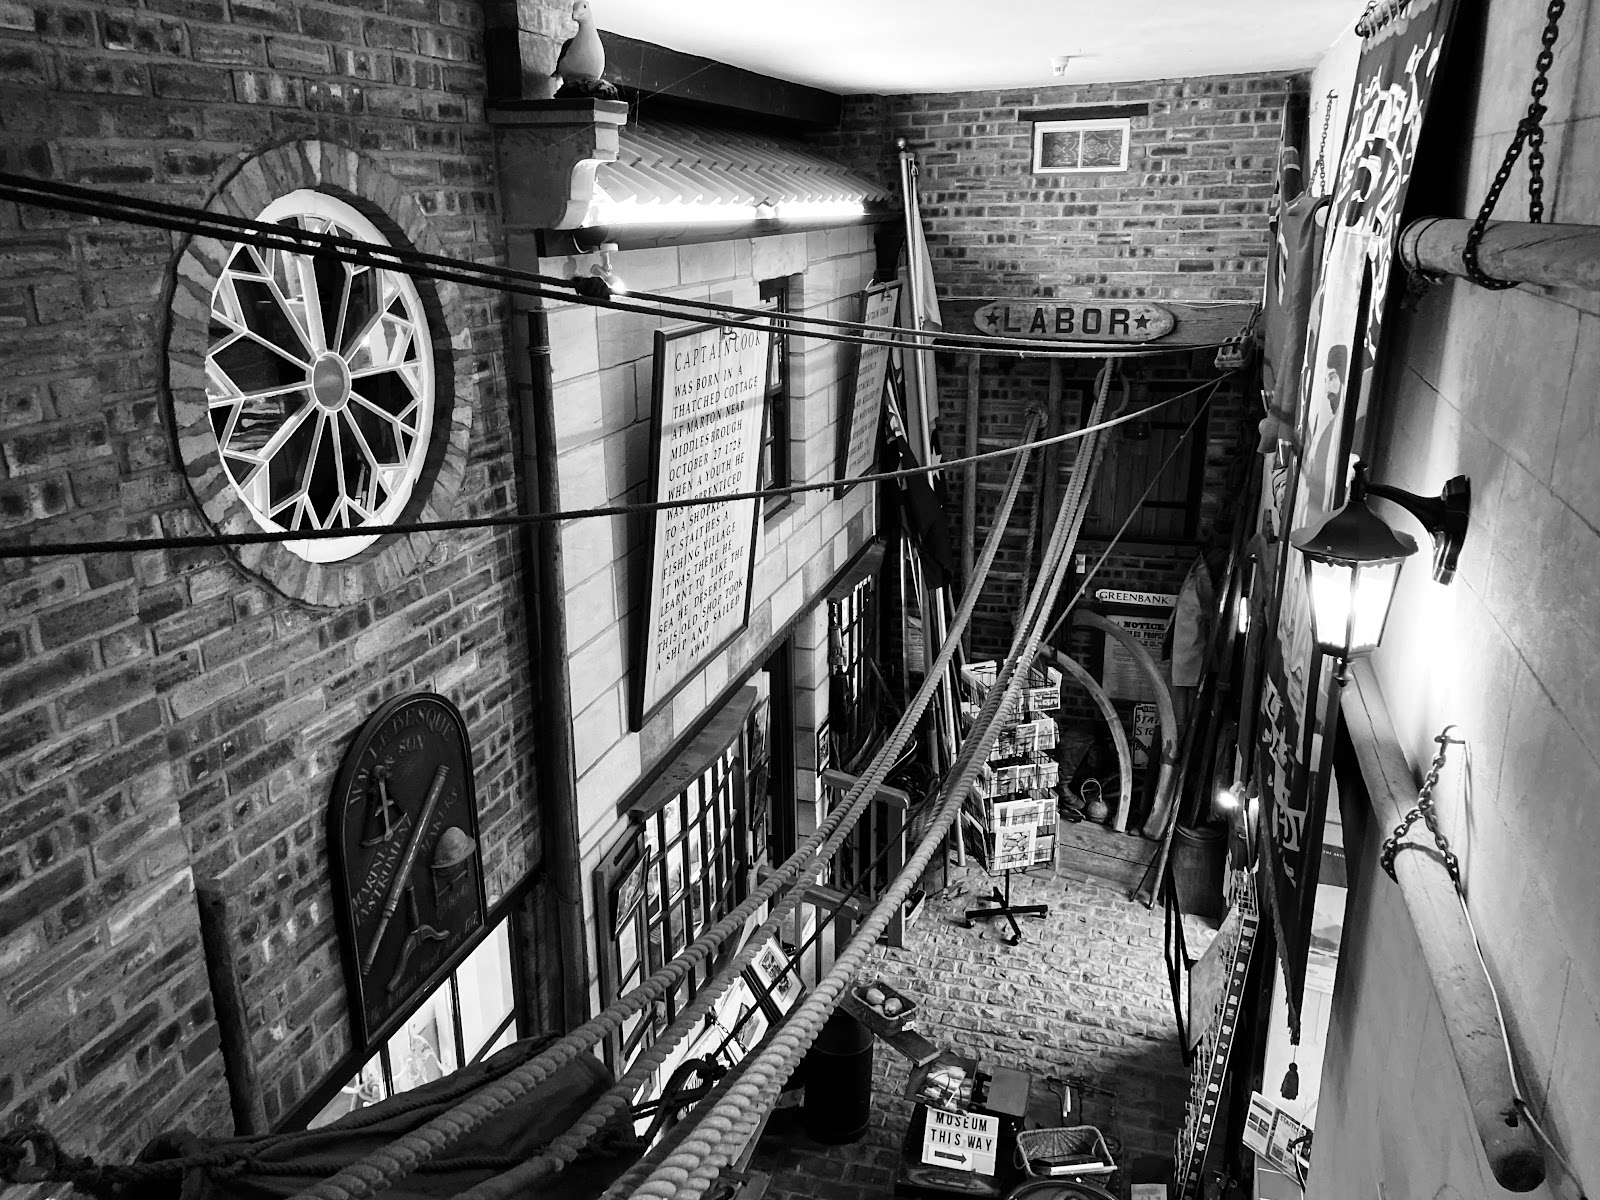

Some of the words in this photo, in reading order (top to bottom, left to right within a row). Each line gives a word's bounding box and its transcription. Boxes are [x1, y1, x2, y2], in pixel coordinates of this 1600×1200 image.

[1003, 306, 1130, 335] LABOR
[675, 340, 730, 371] CAPTAIN
[734, 331, 760, 352] COOK
[673, 390, 720, 419] THATCHED
[724, 375, 758, 399] COTTAGE
[674, 381, 693, 398] WAS
[696, 371, 719, 391] BORN
[724, 367, 733, 381] IN
[738, 365, 743, 376] A
[671, 424, 684, 441] AT
[687, 408, 722, 435] MARTON
[726, 400, 745, 418] NEAR
[671, 419, 743, 462] MIDDLESBROUGH
[668, 478, 693, 502] WHEN
[697, 474, 702, 487] A
[705, 458, 731, 482] YOUTH
[735, 451, 745, 467] HE
[669, 452, 709, 482] OCTOBER
[713, 447, 722, 460] 27
[725, 438, 741, 454] 1728
[667, 505, 684, 521] WAS
[688, 470, 742, 511] PPRENTICED
[663, 545, 700, 580] FISHING
[703, 521, 736, 551] VILLAGE
[665, 525, 677, 541] TO
[680, 520, 686, 533] A
[665, 544, 676, 560] AT
[679, 515, 720, 551] STAITHES
[723, 510, 729, 521] A
[660, 584, 693, 617] LEARNT
[695, 574, 705, 589] TO
[710, 557, 728, 578] LIKE
[731, 546, 744, 563] THE
[661, 584, 671, 599] IT
[674, 569, 690, 589] WAS
[694, 549, 719, 575] THERE
[722, 540, 732, 555] HE
[657, 629, 678, 655] THIS
[681, 613, 698, 635] OLD
[702, 594, 721, 618] SHOP
[725, 577, 744, 599] TOOK
[658, 616, 674, 637] SEA
[678, 604, 689, 621] HE
[694, 570, 734, 608] DESERTED
[1099, 591, 1169, 605] GREENBANK
[655, 661, 661, 673] A
[665, 638, 687, 665] SHIP
[690, 620, 710, 643] AND
[712, 594, 740, 624] SAILED
[689, 632, 711, 660] AWAY
[1123, 621, 1166, 631] NOTICE
[398, 733, 427, 756] SON
[931, 1128, 961, 1146] THIS
[967, 1135, 992, 1152] WAY
[935, 1111, 988, 1132] MUSEUM
